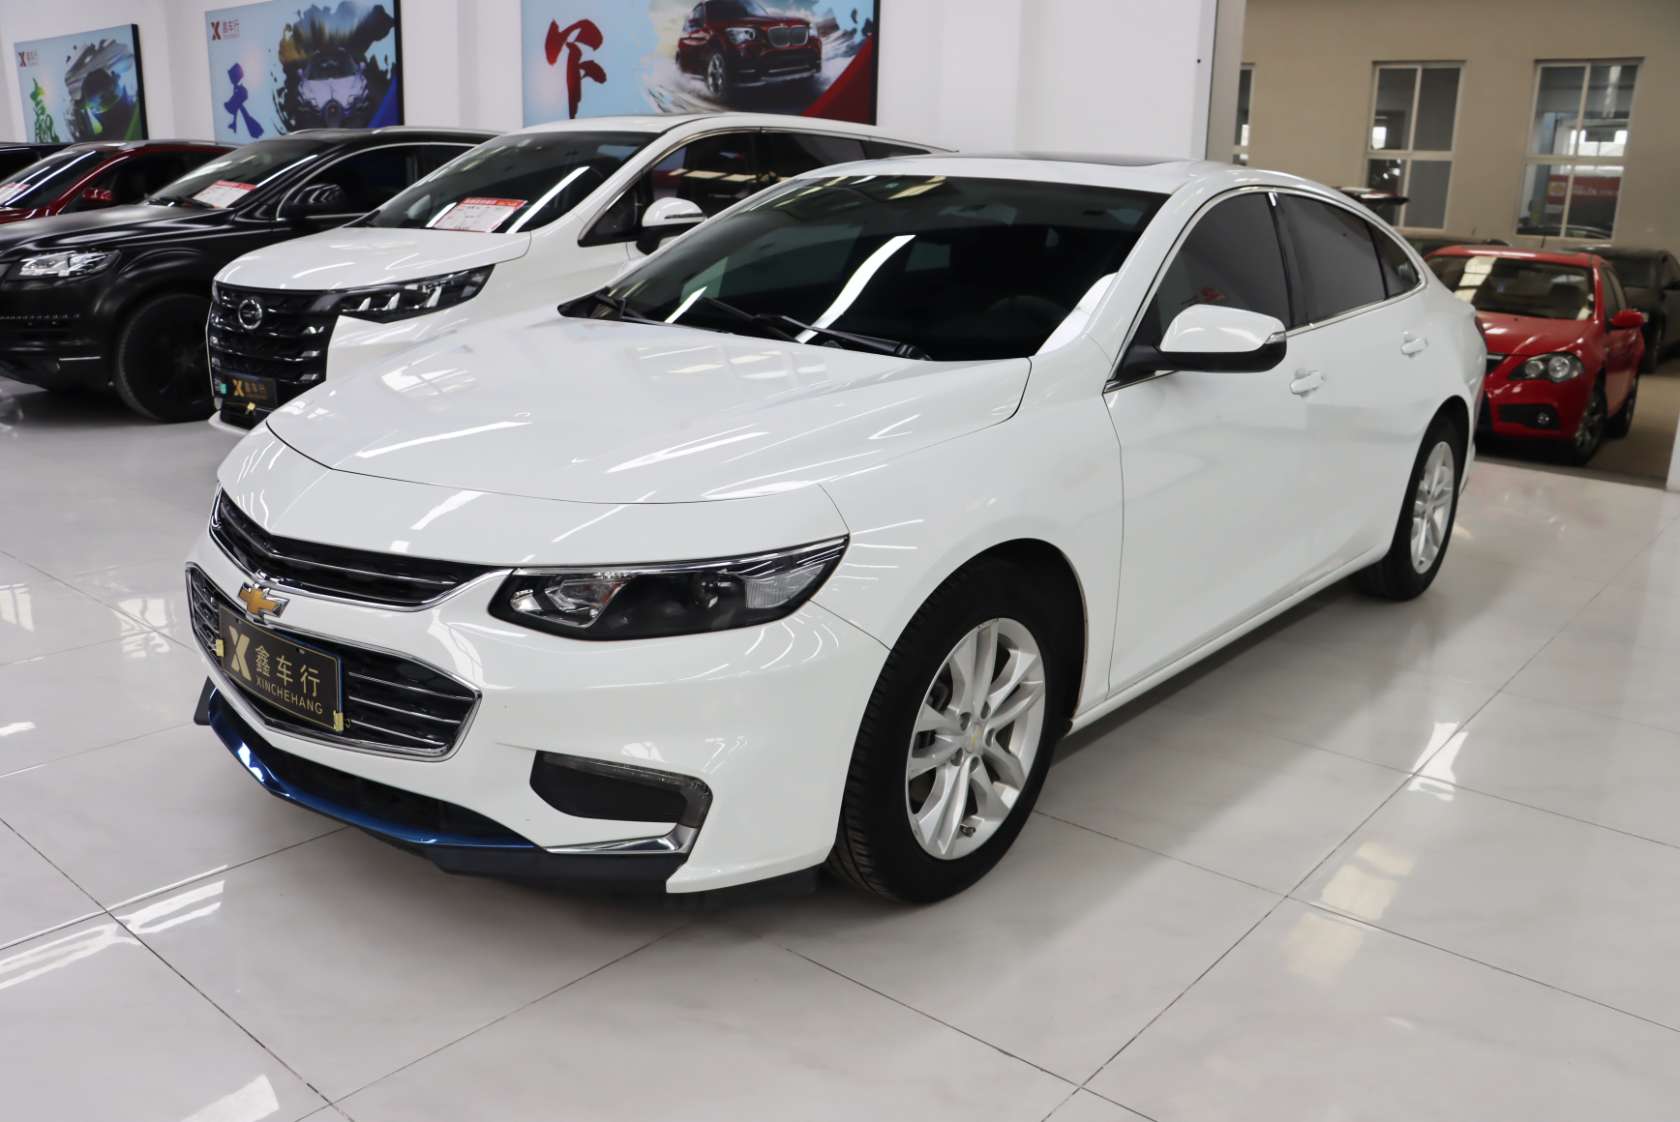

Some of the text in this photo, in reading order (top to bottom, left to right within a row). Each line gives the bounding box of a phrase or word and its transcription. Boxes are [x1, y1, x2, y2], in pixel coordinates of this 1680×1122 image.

[255, 646, 320, 697] 鑫车行
[256, 677, 323, 714] XINCHEHANG
